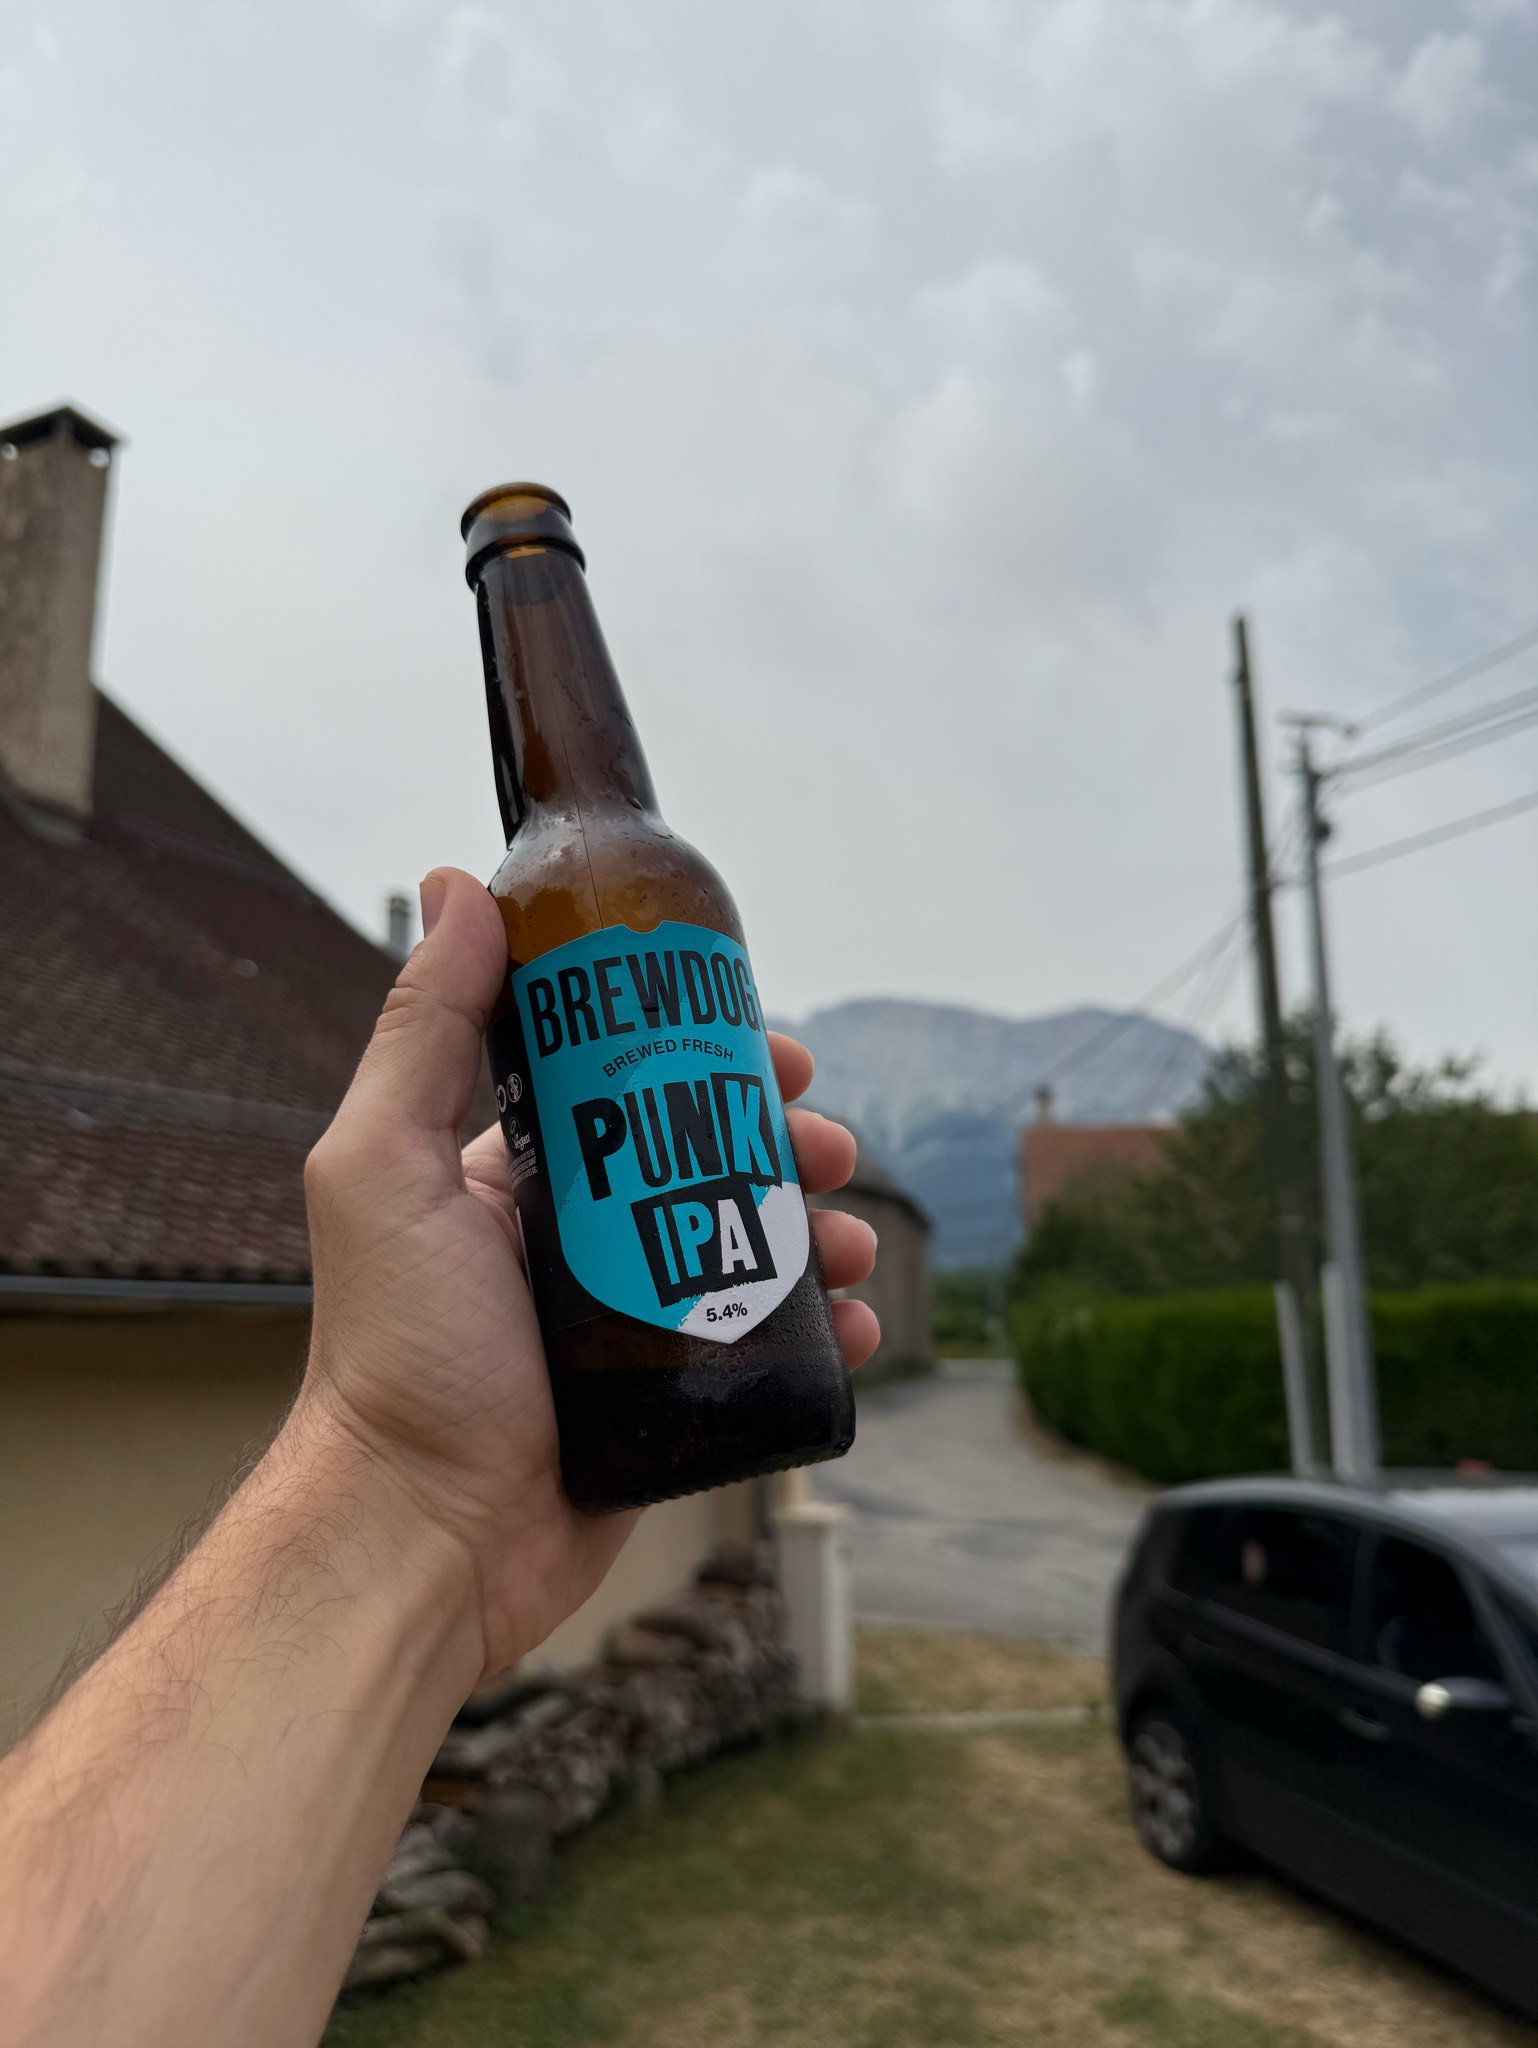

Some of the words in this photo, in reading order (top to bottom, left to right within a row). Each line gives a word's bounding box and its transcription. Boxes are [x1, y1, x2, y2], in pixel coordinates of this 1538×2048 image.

[527, 950, 761, 1059] BREWDOG
[602, 1039, 677, 1078] BREWED
[682, 1038, 734, 1062] FRESH
[572, 1077, 778, 1201] PUNK
[653, 1199, 758, 1285] IPA
[706, 1302, 748, 1322] 5.4%
